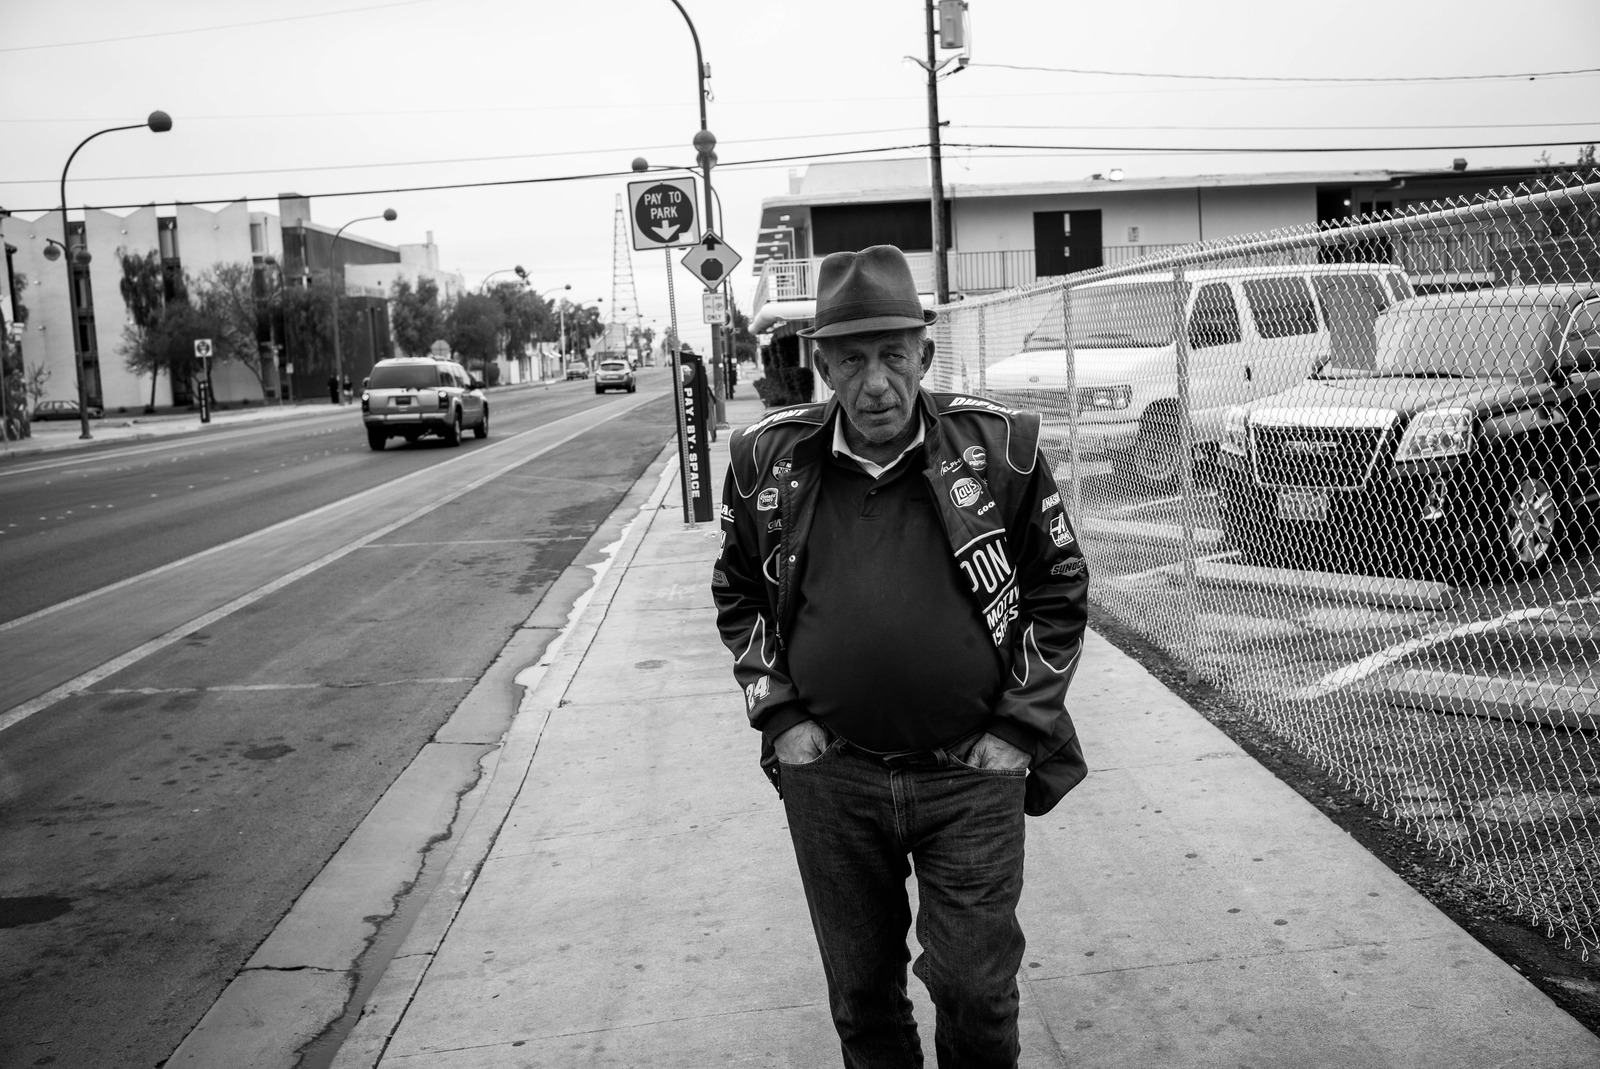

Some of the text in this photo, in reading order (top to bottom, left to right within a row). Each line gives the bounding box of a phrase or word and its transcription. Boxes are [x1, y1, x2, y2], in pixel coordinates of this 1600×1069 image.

[644, 190, 682, 206] PAY TO
[650, 206, 678, 220] PARK
[683, 387, 700, 498] PAY BY SPACE
[746, 675, 770, 712] 24
